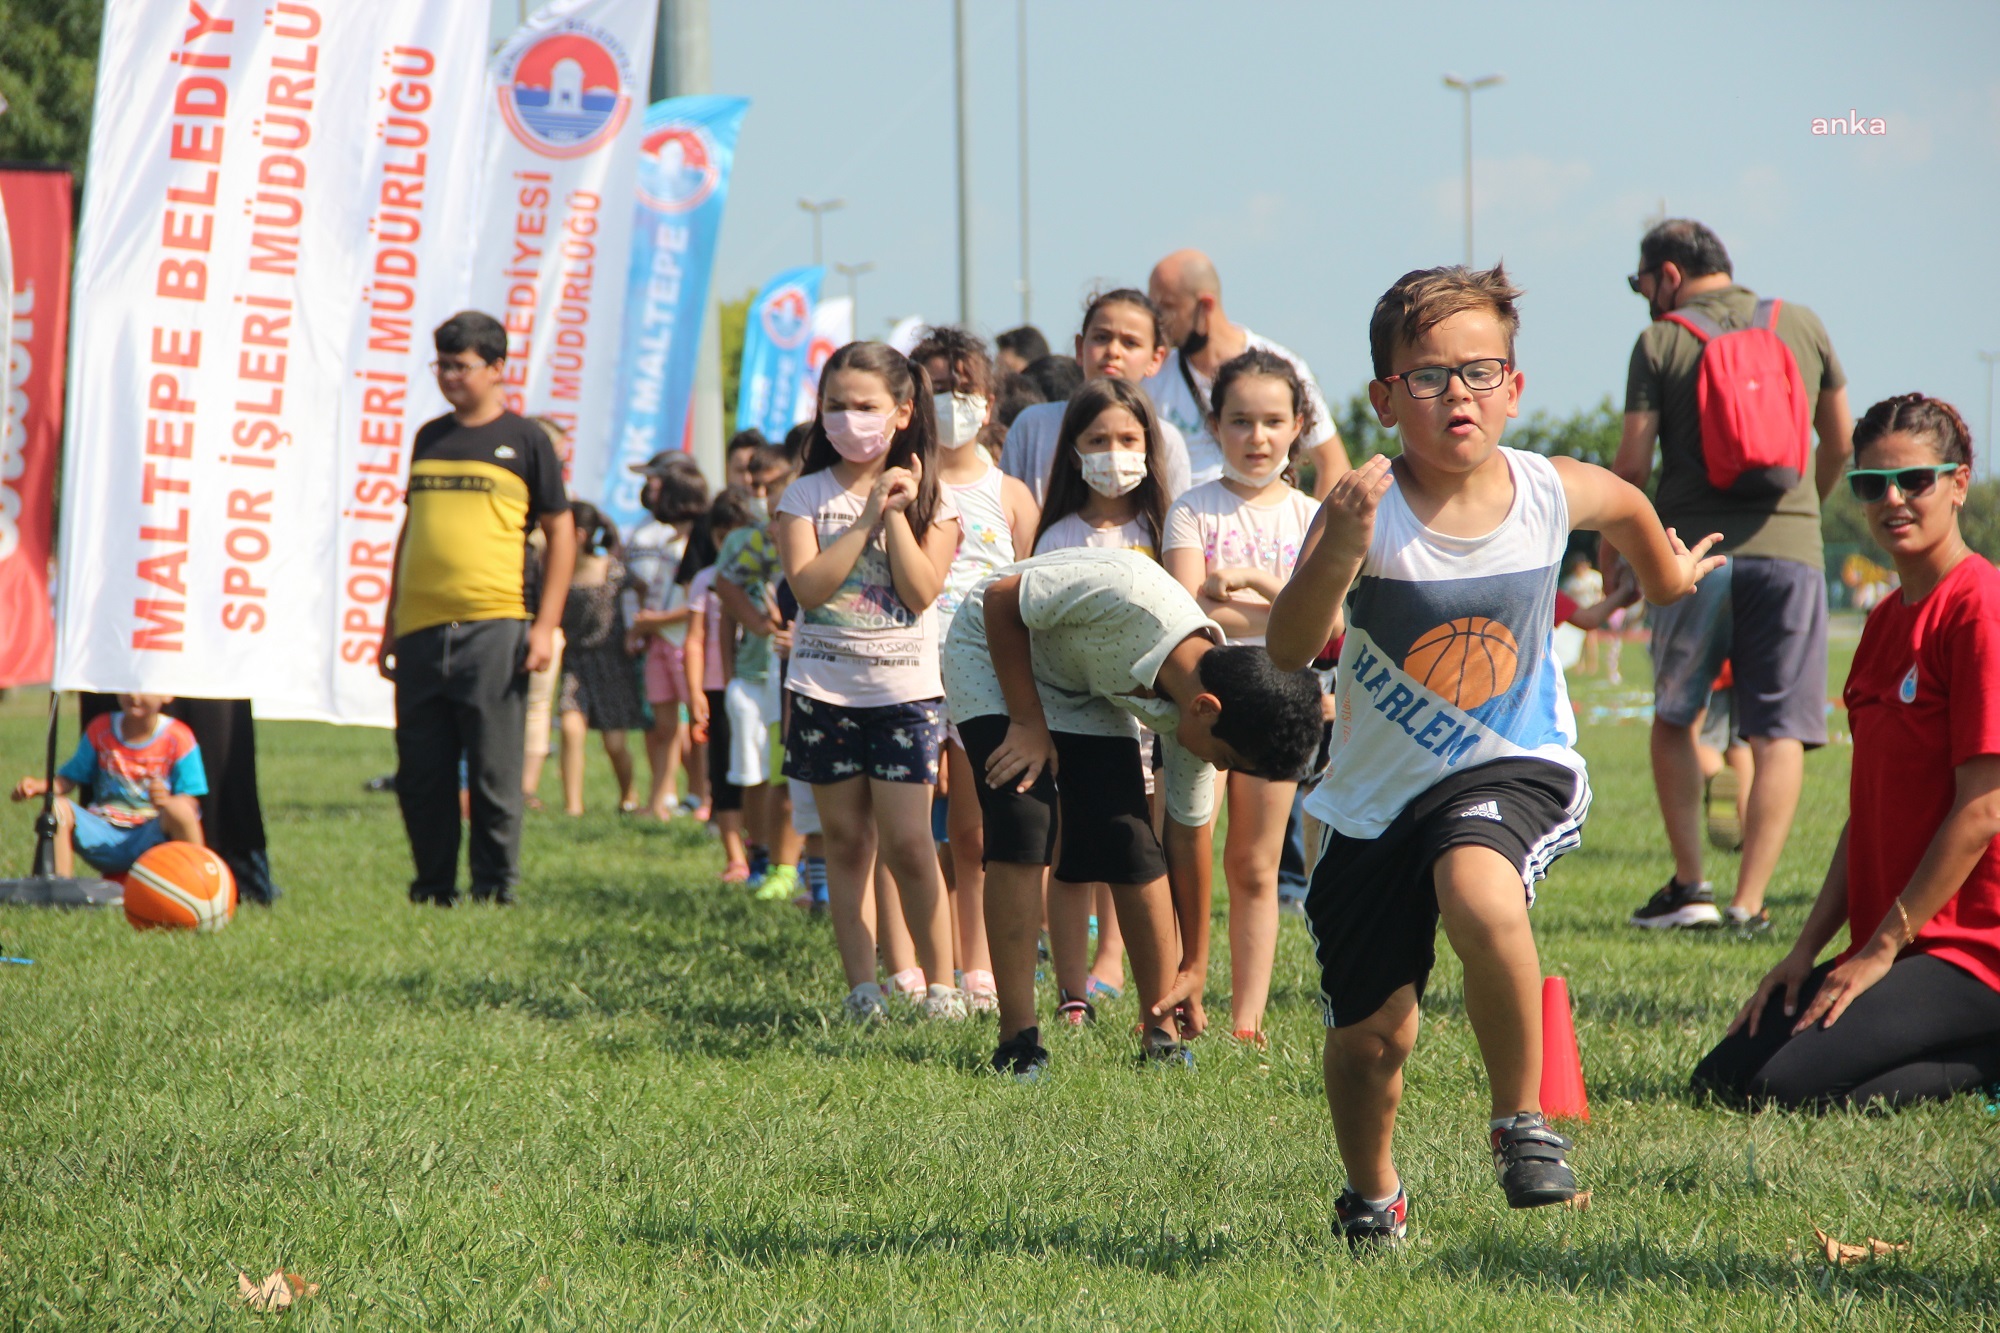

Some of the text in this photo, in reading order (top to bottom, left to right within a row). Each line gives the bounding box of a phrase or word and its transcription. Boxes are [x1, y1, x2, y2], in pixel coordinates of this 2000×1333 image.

[219, 0, 323, 634] SPOR İŞLERİ MÜDÜRLÜ
[342, 46, 436, 667] SPOR İŞLERİ MÜDÜRLÜĞÜ
[503, 172, 552, 416] BELEDİYESİ
[548, 189, 602, 401] MÜDÜRLÜĞÜ
[631, 222, 690, 414] MALTEPE
[132, 327, 202, 652] MALTEPE
[866, 641, 922, 654] PASSION
[1352, 643, 1481, 767] HARLEM
[1461, 810, 1503, 821] adidas
